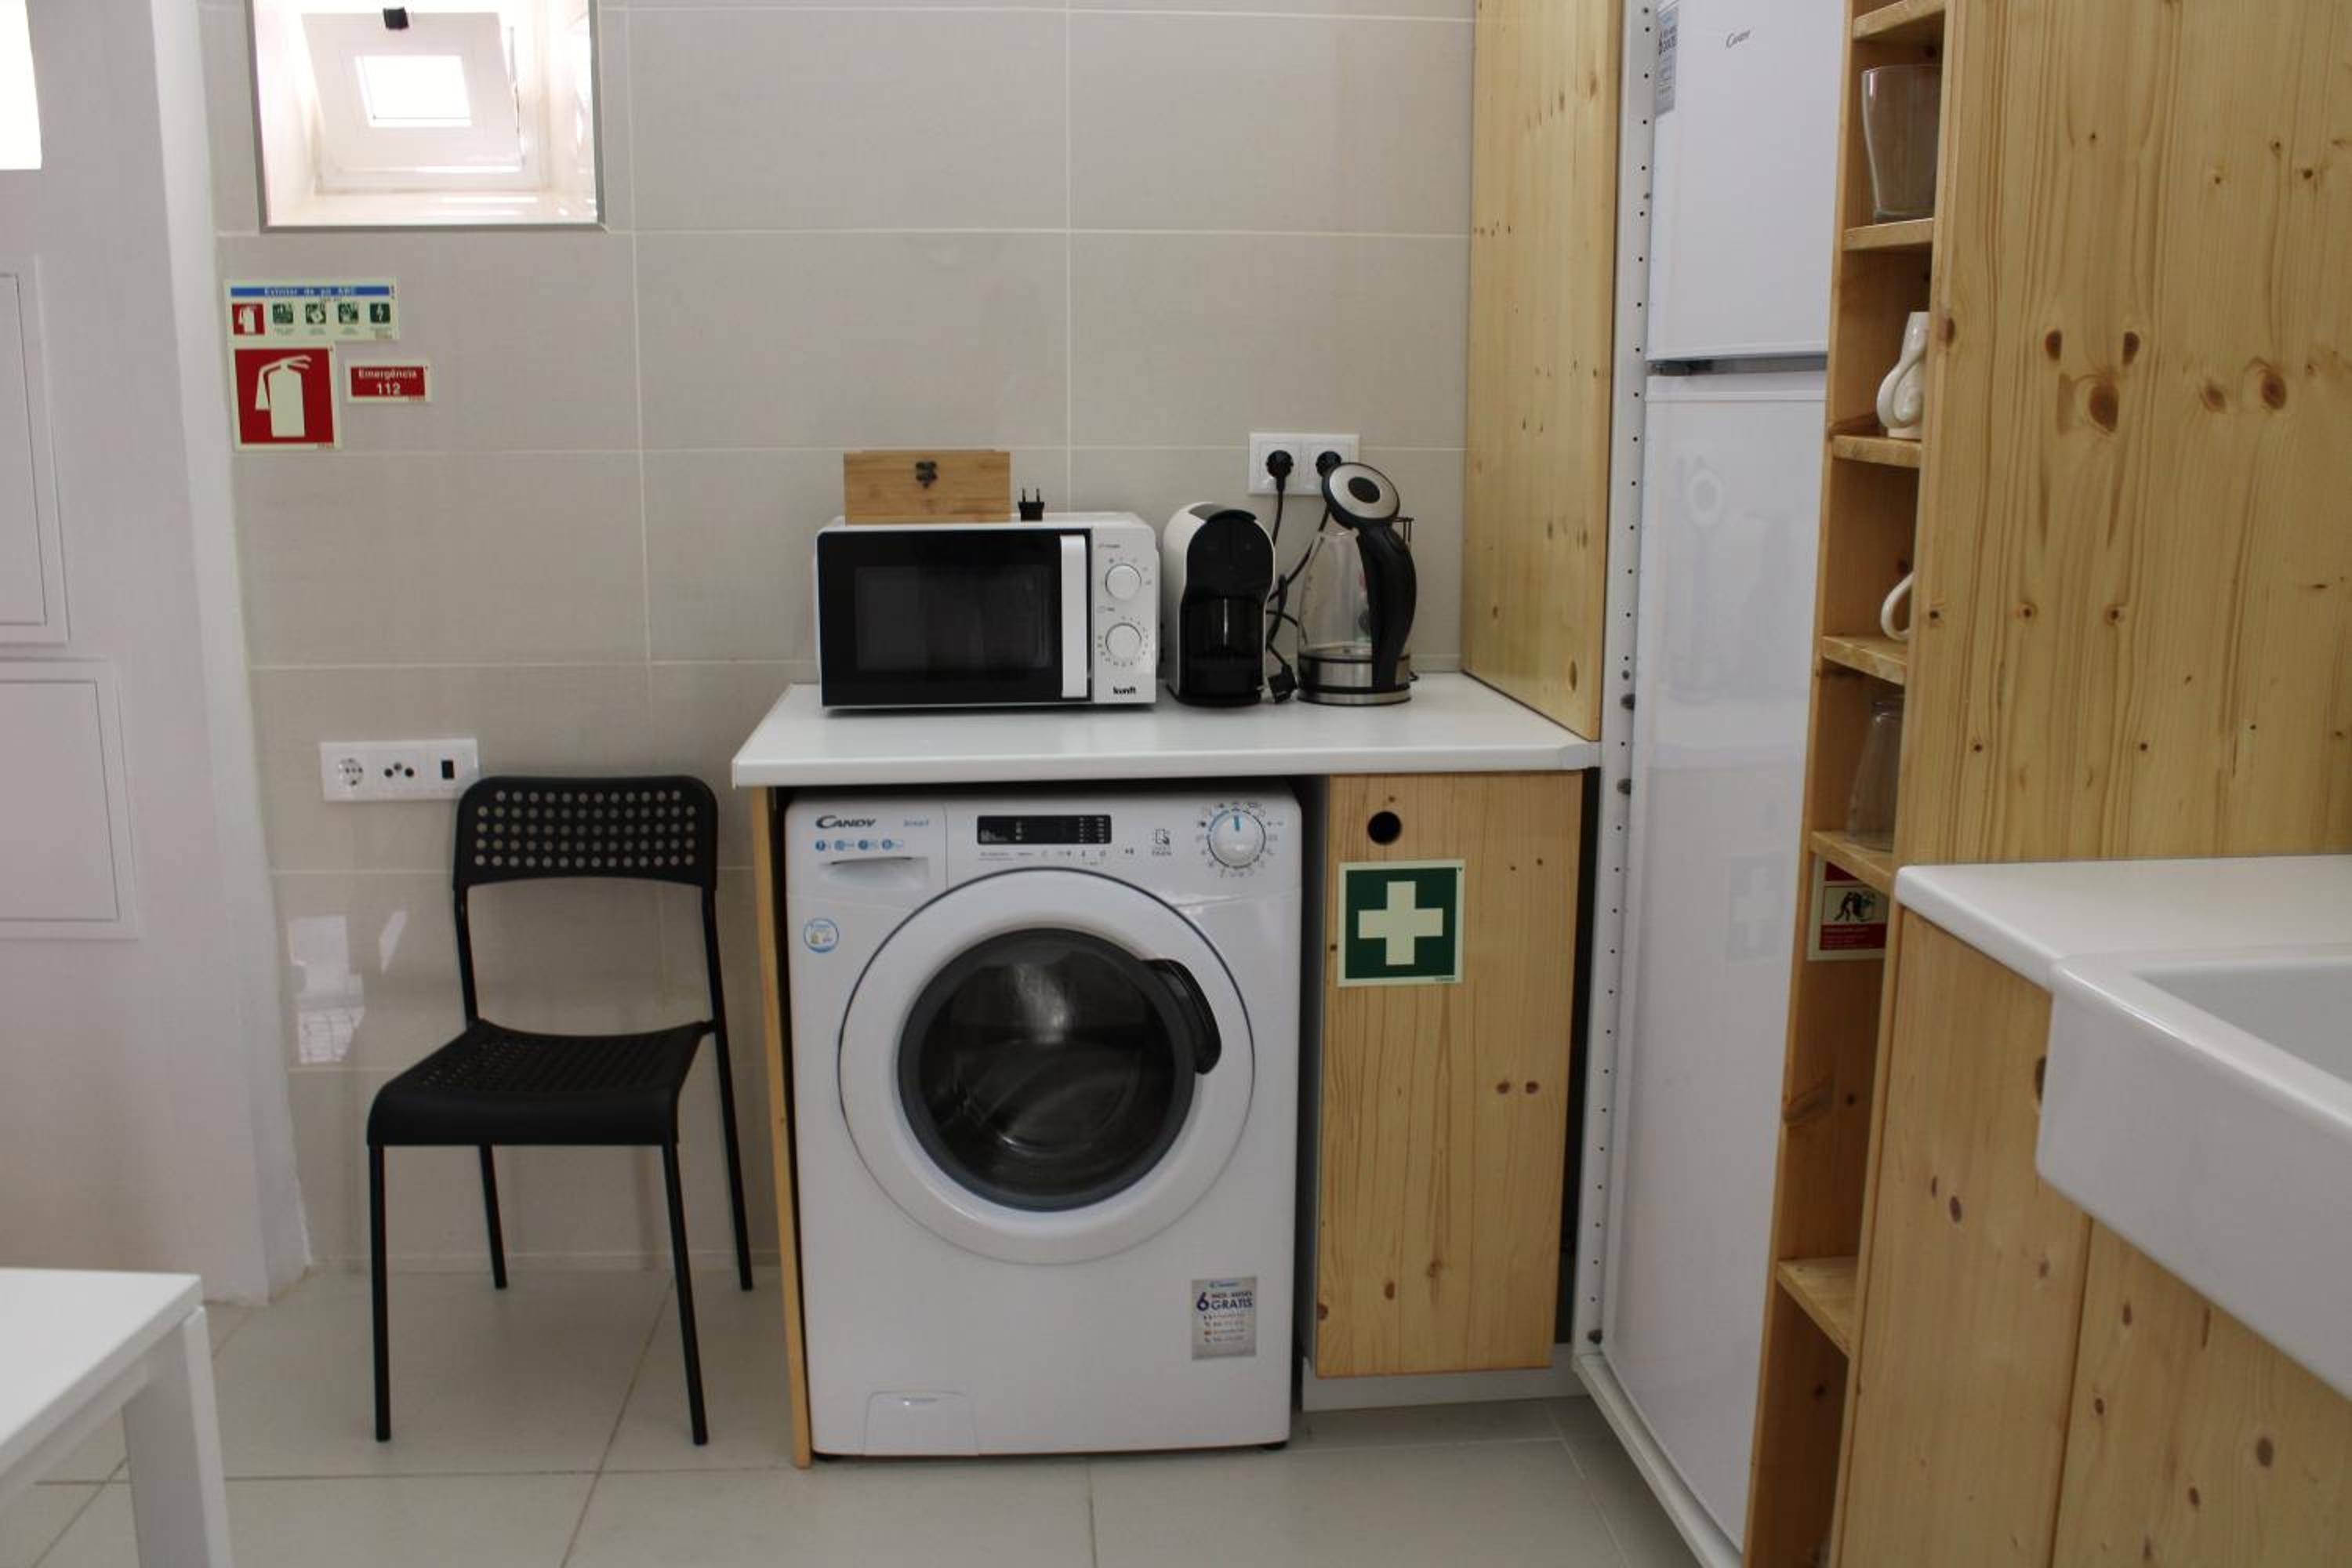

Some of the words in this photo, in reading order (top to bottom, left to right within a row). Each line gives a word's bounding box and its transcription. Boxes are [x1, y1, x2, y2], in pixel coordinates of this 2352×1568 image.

[358, 368, 417, 380] Emergência
[376, 382, 401, 395] 112
[1196, 1291, 1209, 1312] 6
